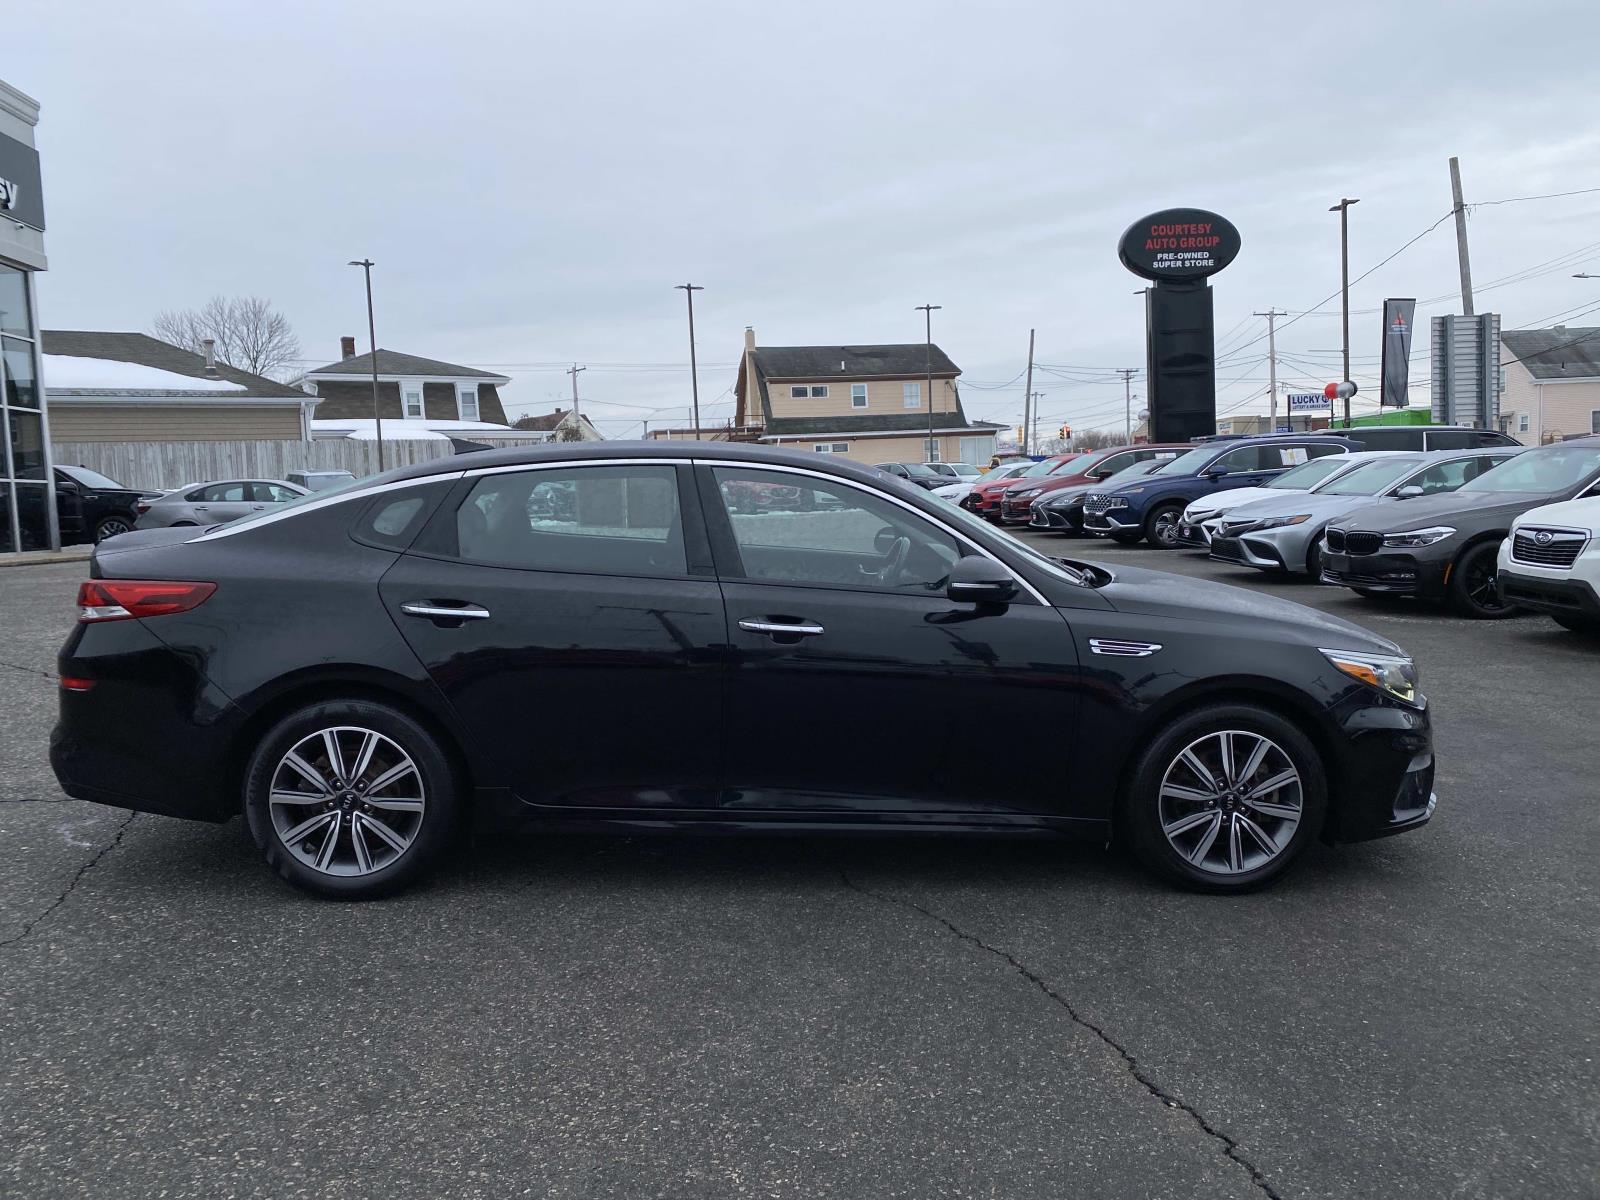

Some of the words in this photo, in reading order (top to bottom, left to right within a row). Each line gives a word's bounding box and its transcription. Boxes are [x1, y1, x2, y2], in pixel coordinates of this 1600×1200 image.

[1151, 224, 1211, 235] COURTESY
[1145, 239, 1176, 249] AUTO
[1180, 237, 1220, 248] GROUP
[1157, 252, 1209, 260] PRE-OWNED
[1292, 395, 1320, 404] LUCKY
